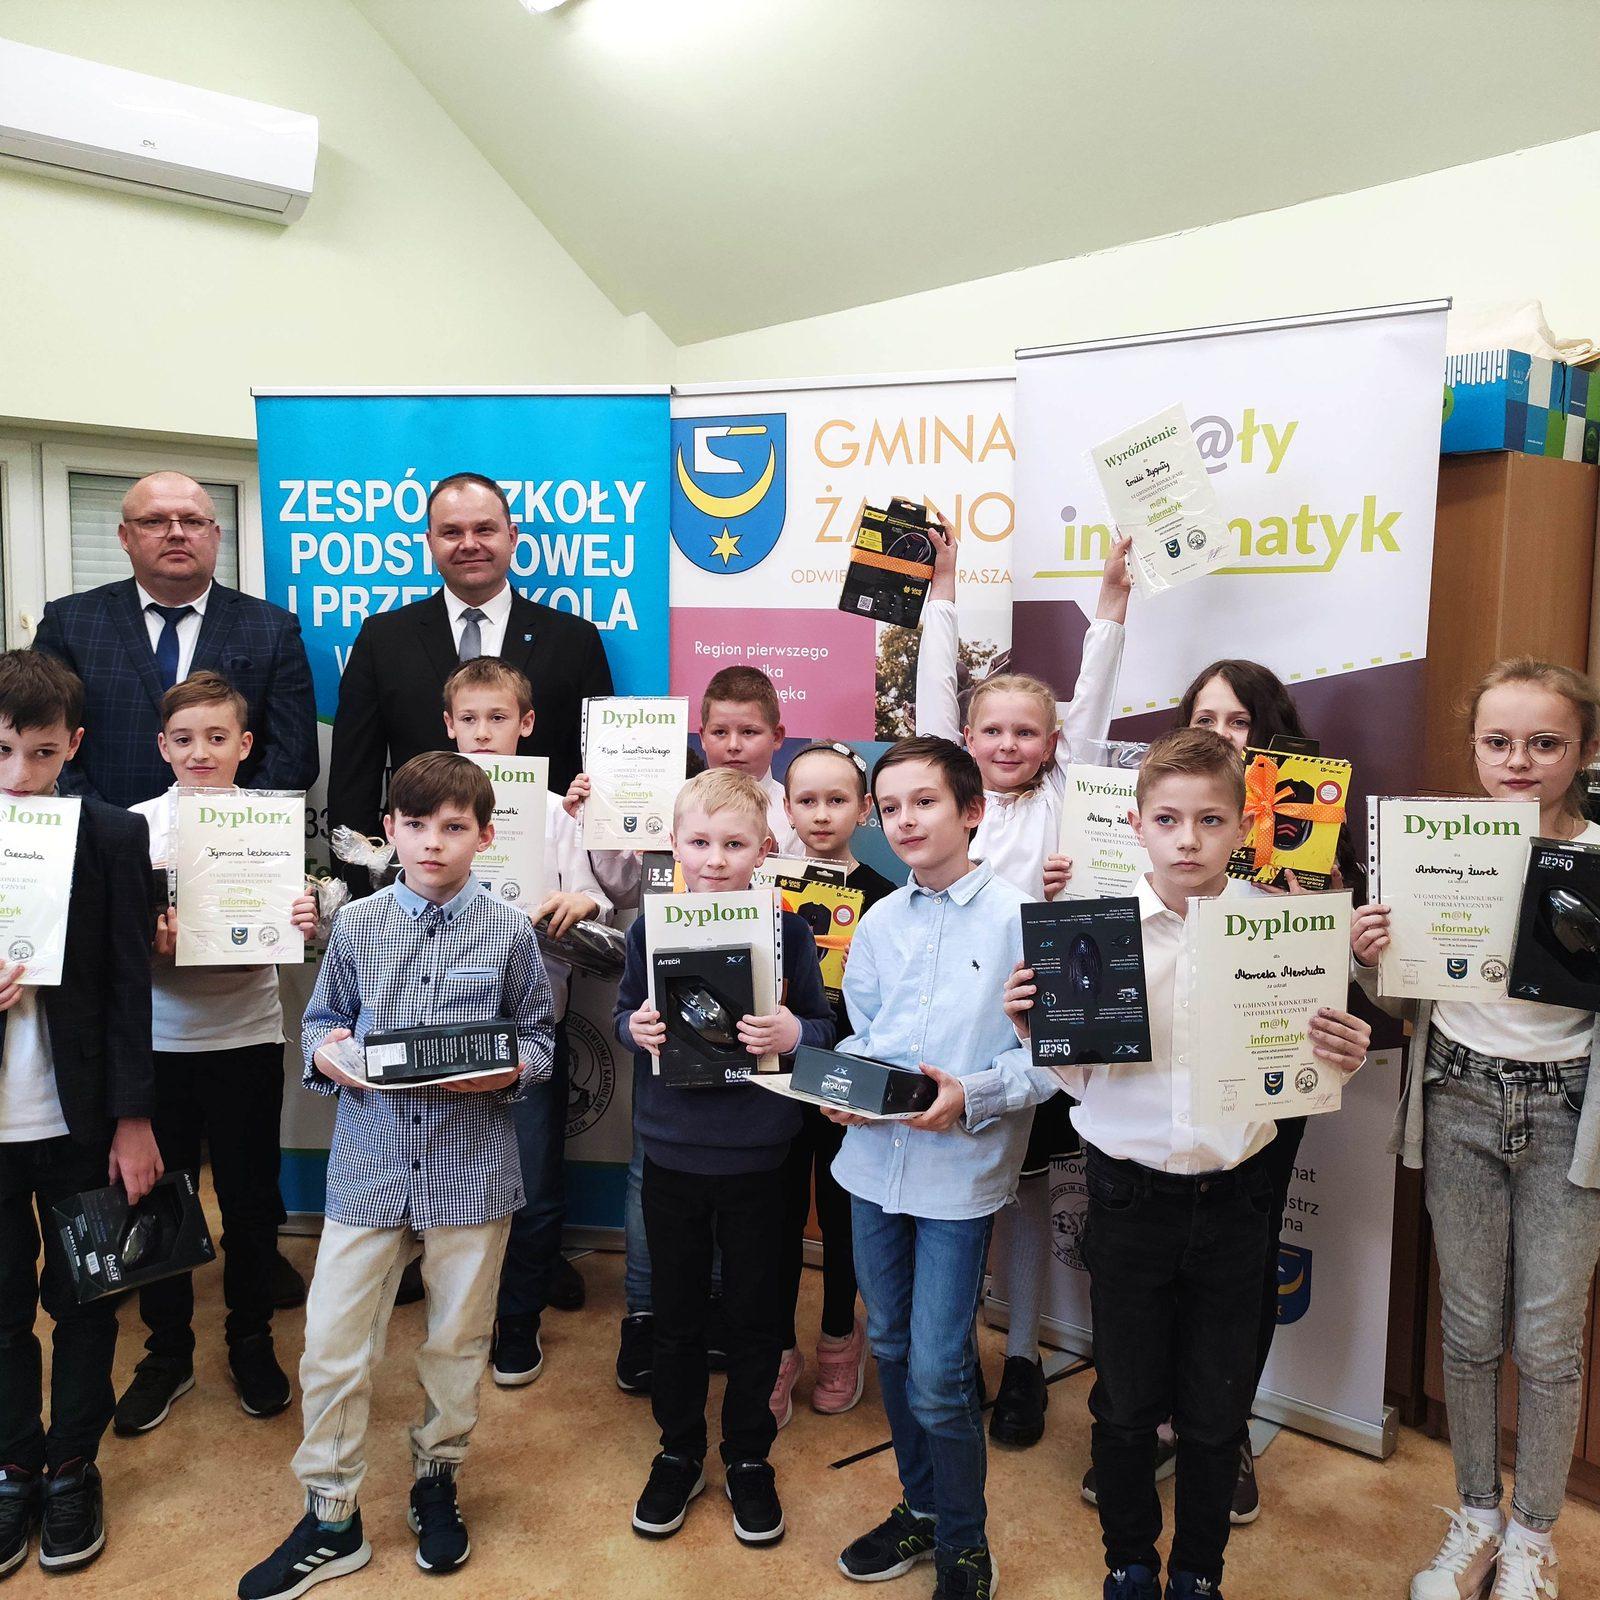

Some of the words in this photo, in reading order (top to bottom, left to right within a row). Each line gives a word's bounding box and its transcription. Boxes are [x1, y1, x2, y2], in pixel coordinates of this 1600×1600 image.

[814, 412, 1016, 468] GMINA
[1104, 424, 1178, 469] Wyróżnienie
[1190, 408, 1299, 474] @ły
[279, 467, 438, 523] ZESPÓ
[496, 479, 647, 524] ZKOŁY
[815, 485, 1015, 543] ŻNO
[1147, 502, 1183, 523] informatyk
[291, 532, 635, 577] PODSTOWEJ
[791, 569, 846, 584] ODWIE
[957, 568, 1013, 584] RASZA
[313, 585, 639, 630] PRZOLA
[694, 640, 742, 659] Region
[746, 643, 829, 661] pierwszego
[601, 709, 676, 728] Dyplom
[198, 806, 292, 828] Dyplom
[1403, 814, 1522, 840] Dyplom
[1099, 849, 1123, 858] m@ły
[1539, 855, 1574, 871] Oscar
[1091, 858, 1137, 872] informatyk
[1415, 864, 1463, 880] Antoniny
[651, 868, 673, 882] 3.5
[664, 902, 760, 927] Dyplom
[1423, 901, 1493, 909] INFORMATYCZNYM
[1440, 911, 1472, 920] m@ły
[1224, 910, 1336, 941] Dyplom
[1431, 923, 1490, 936] informatyk
[1234, 968, 1277, 980] Marcela
[1242, 1001, 1278, 1009] GMINNYM
[1278, 998, 1318, 1006] KONKURSIE
[1243, 1006, 1308, 1017] INFORMATYCZNYM
[1260, 1018, 1289, 1030] m@ły
[497, 1033, 509, 1060] Oscar
[1250, 1032, 1305, 1045] informatyk
[1039, 1043, 1071, 1056] Oscar
[105, 1253, 120, 1281] Oscar
